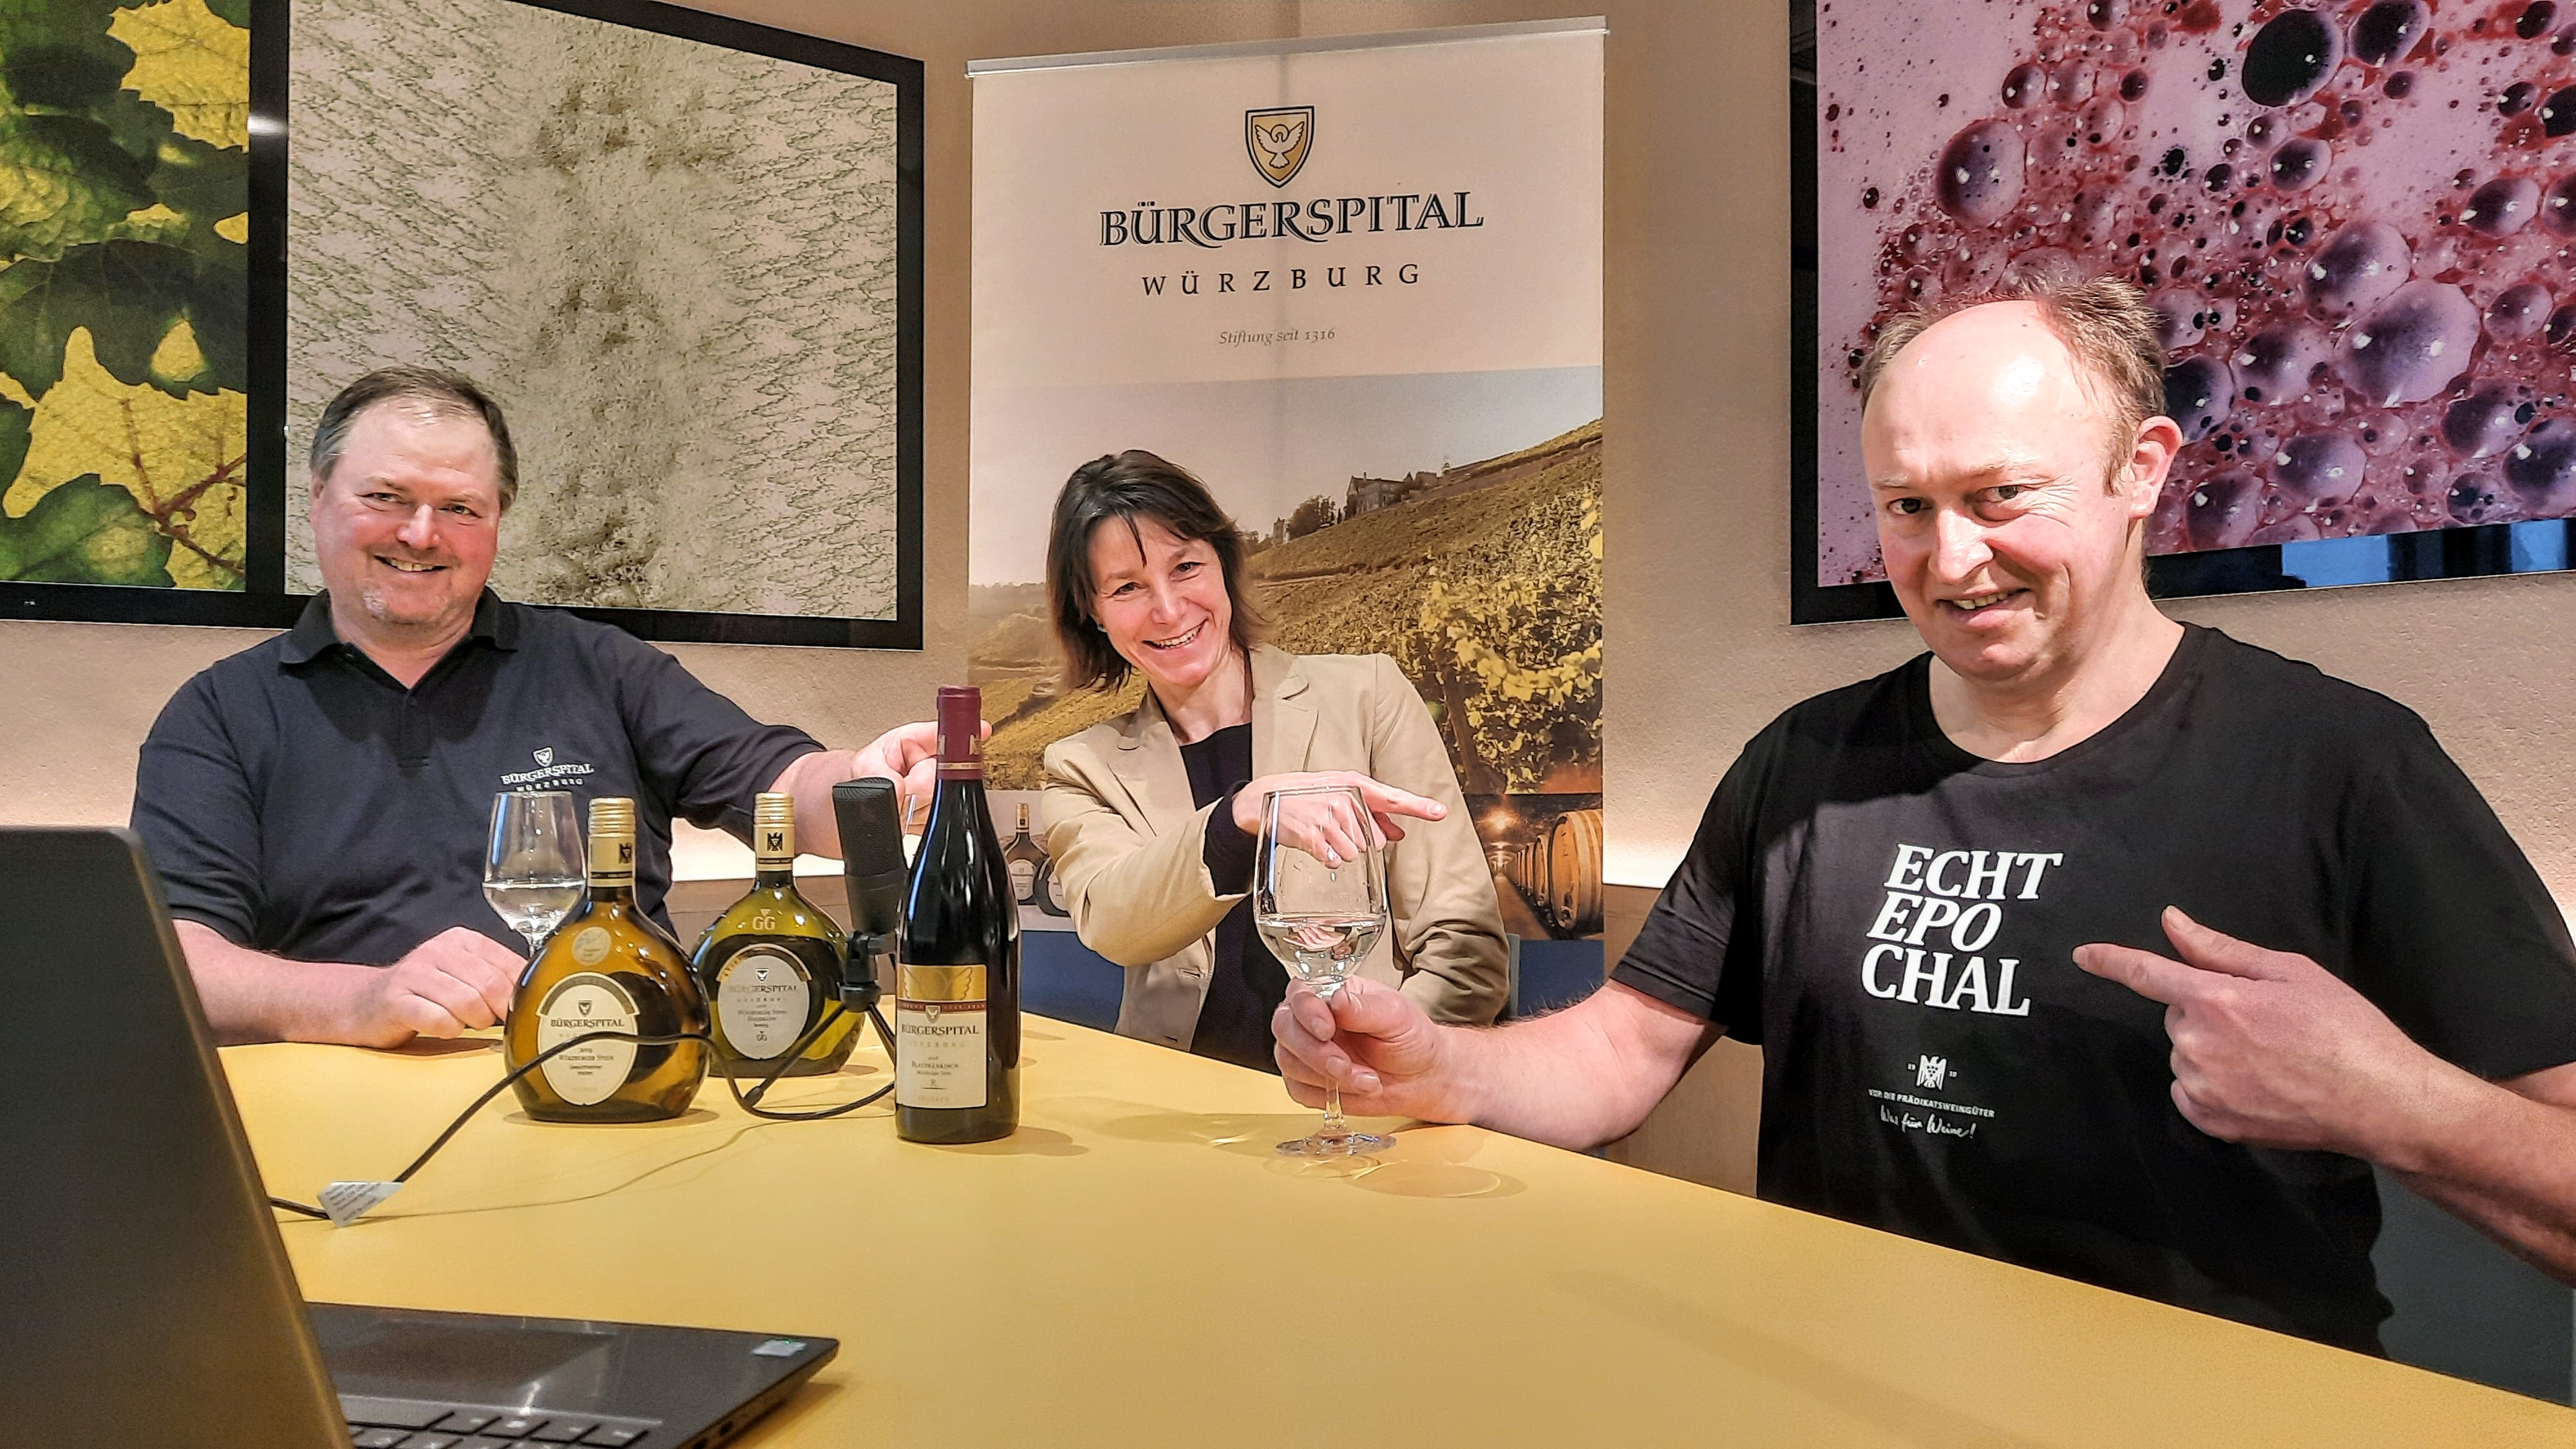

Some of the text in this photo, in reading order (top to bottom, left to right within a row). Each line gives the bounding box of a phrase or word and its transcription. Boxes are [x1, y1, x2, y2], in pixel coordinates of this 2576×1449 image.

[1099, 192, 1484, 248] BÜRGERSPITAL
[1142, 263, 1419, 296] WÜRZBURG
[1219, 327, 1336, 348] Stiftung seit 1316
[1883, 844, 2064, 900] ECHT
[752, 916, 776, 931] GG
[1866, 890, 2002, 952] EPO
[1861, 942, 2031, 1017] CHAL
